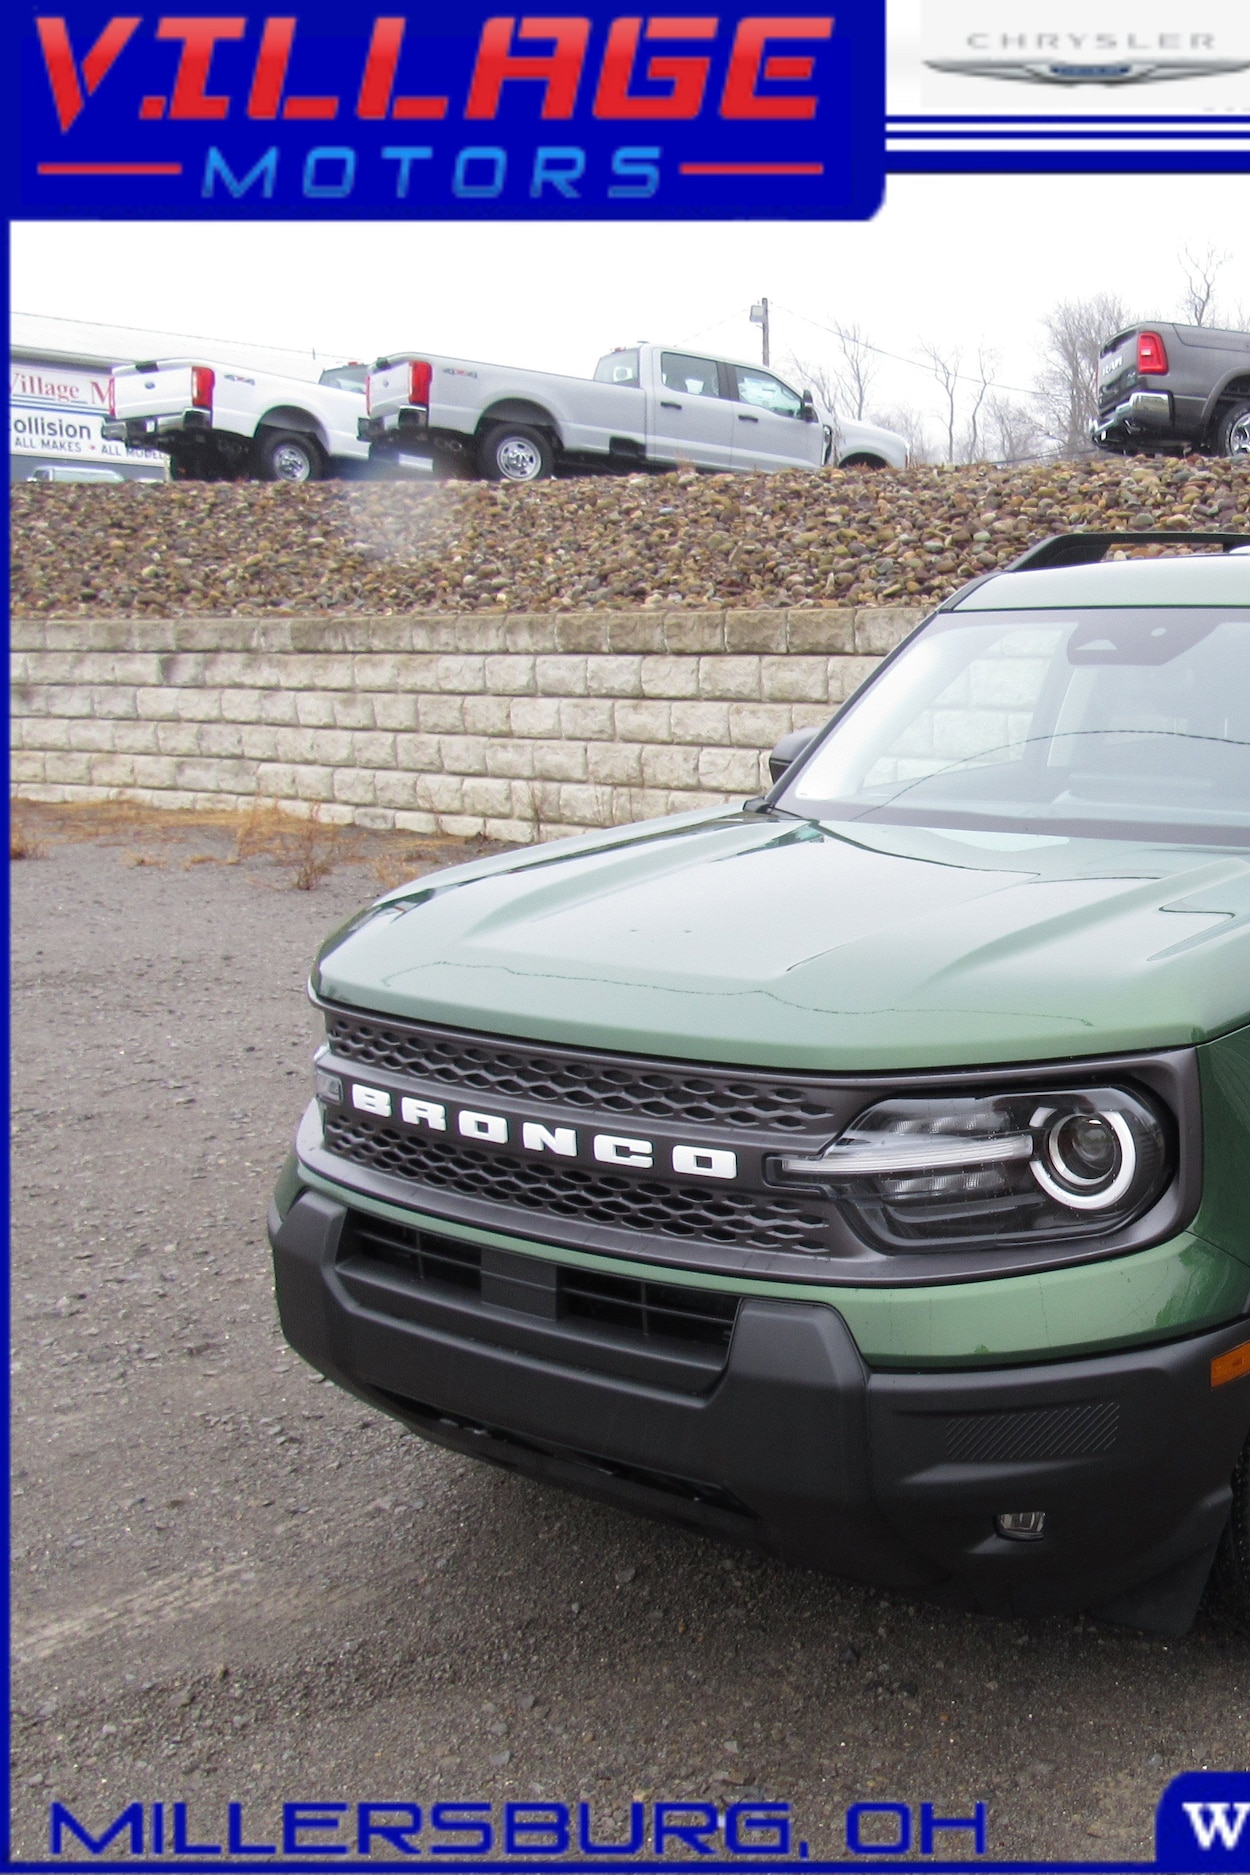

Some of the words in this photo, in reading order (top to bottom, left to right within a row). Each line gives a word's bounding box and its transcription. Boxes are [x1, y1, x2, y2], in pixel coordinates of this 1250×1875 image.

[14, 416, 91, 440] ollision
[14, 437, 36, 449] ALL
[41, 439, 82, 452] MAKES
[101, 444, 122, 456] ALL
[126, 446, 165, 460] MODEL
[351, 1083, 738, 1180] BRONCO
